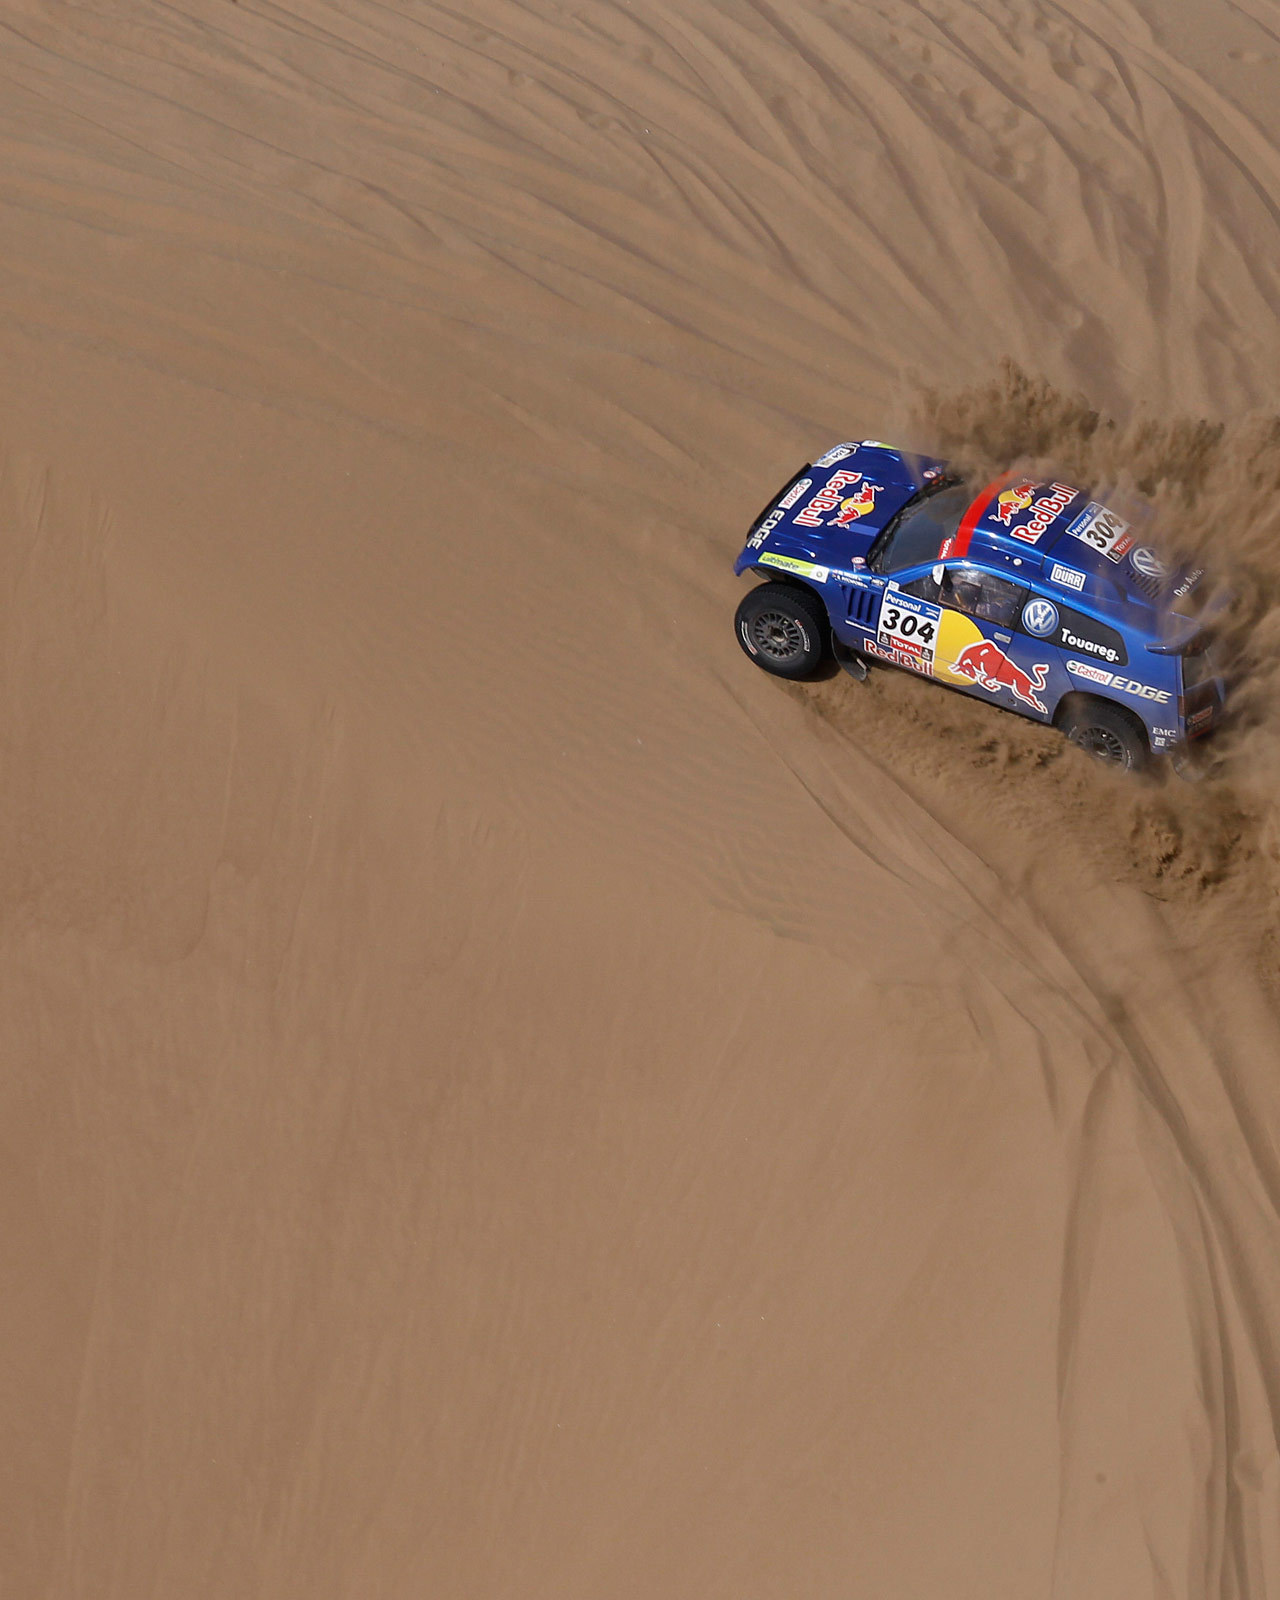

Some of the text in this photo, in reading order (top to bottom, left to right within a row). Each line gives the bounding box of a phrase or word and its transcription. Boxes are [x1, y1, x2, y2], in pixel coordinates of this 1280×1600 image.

[747, 509, 786, 550] EDGE
[1071, 513, 1093, 536] Personal
[1086, 513, 1123, 548] 304
[885, 593, 922, 613] Personal
[1173, 584, 1190, 597] Das
[883, 608, 935, 643] 304
[891, 638, 921, 655] TOTAL
[1061, 628, 1119, 662] Touareg.
[1077, 665, 1173, 704] Castrol EDGE
